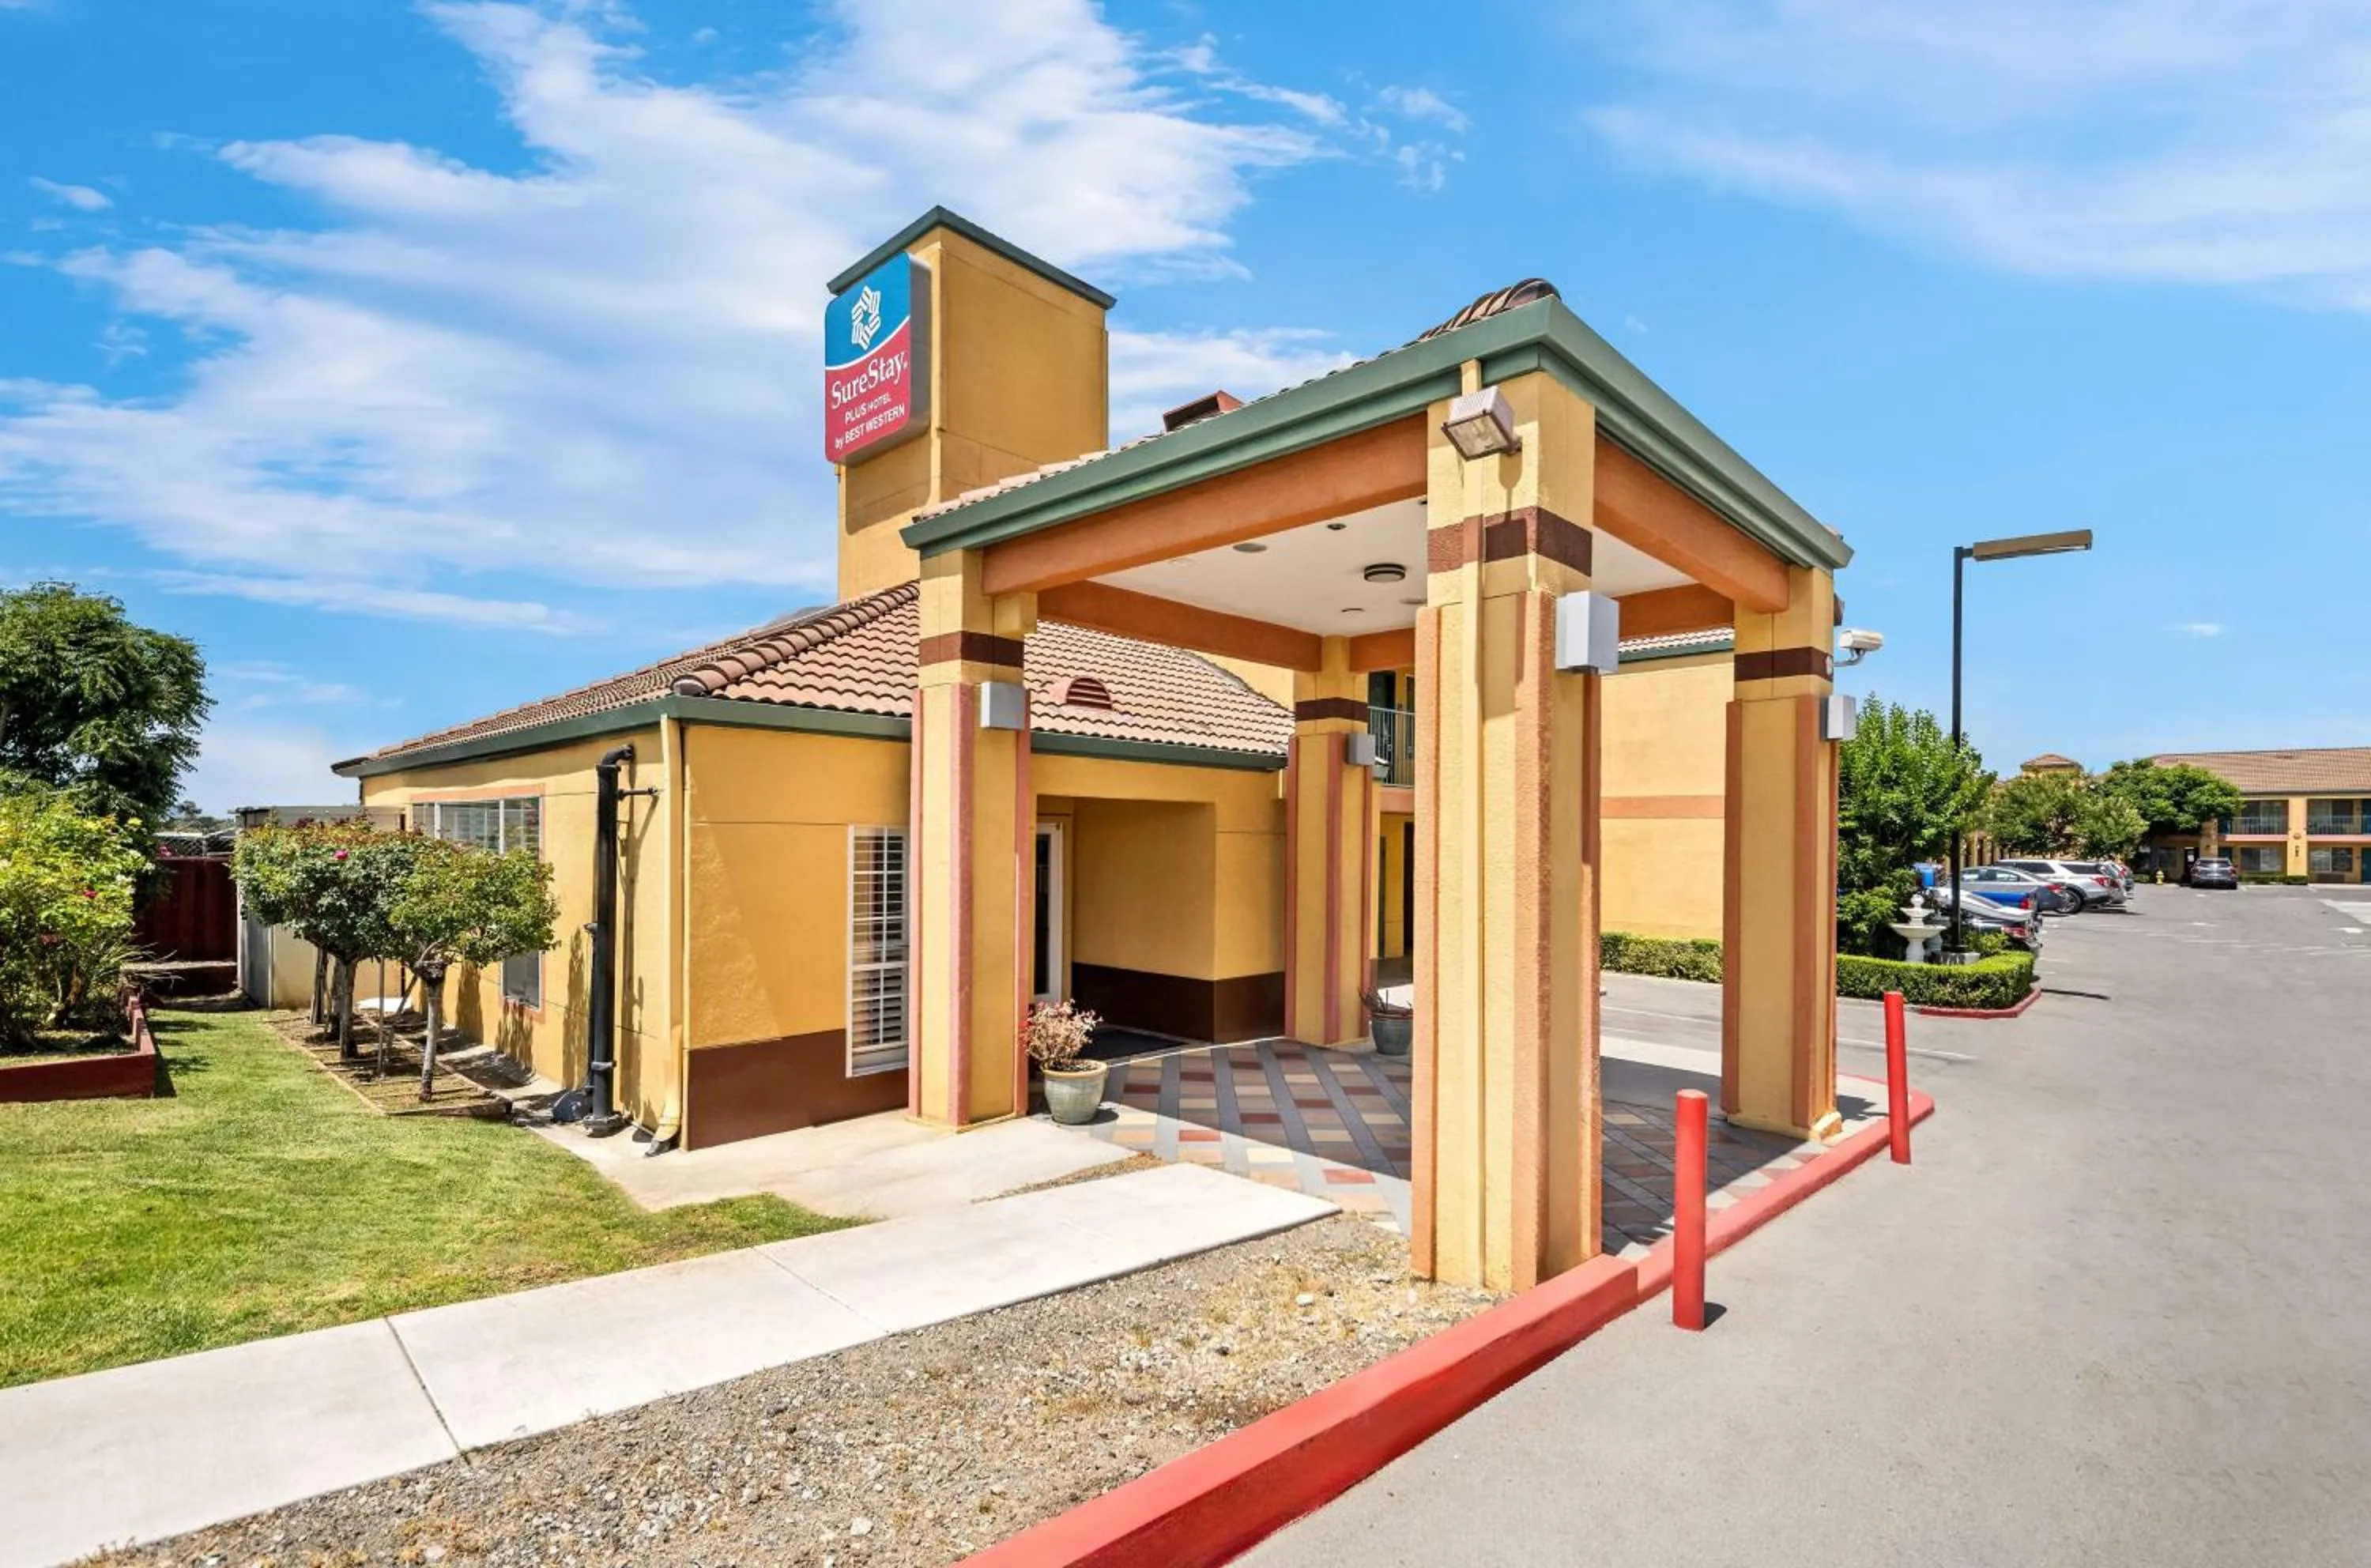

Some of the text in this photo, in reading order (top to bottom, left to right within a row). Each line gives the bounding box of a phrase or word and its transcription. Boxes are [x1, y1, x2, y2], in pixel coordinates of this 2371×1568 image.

[845, 392, 891, 425] PLUS HOTEL
[845, 424, 865, 444] BEST
[865, 403, 905, 432] WESTERN
